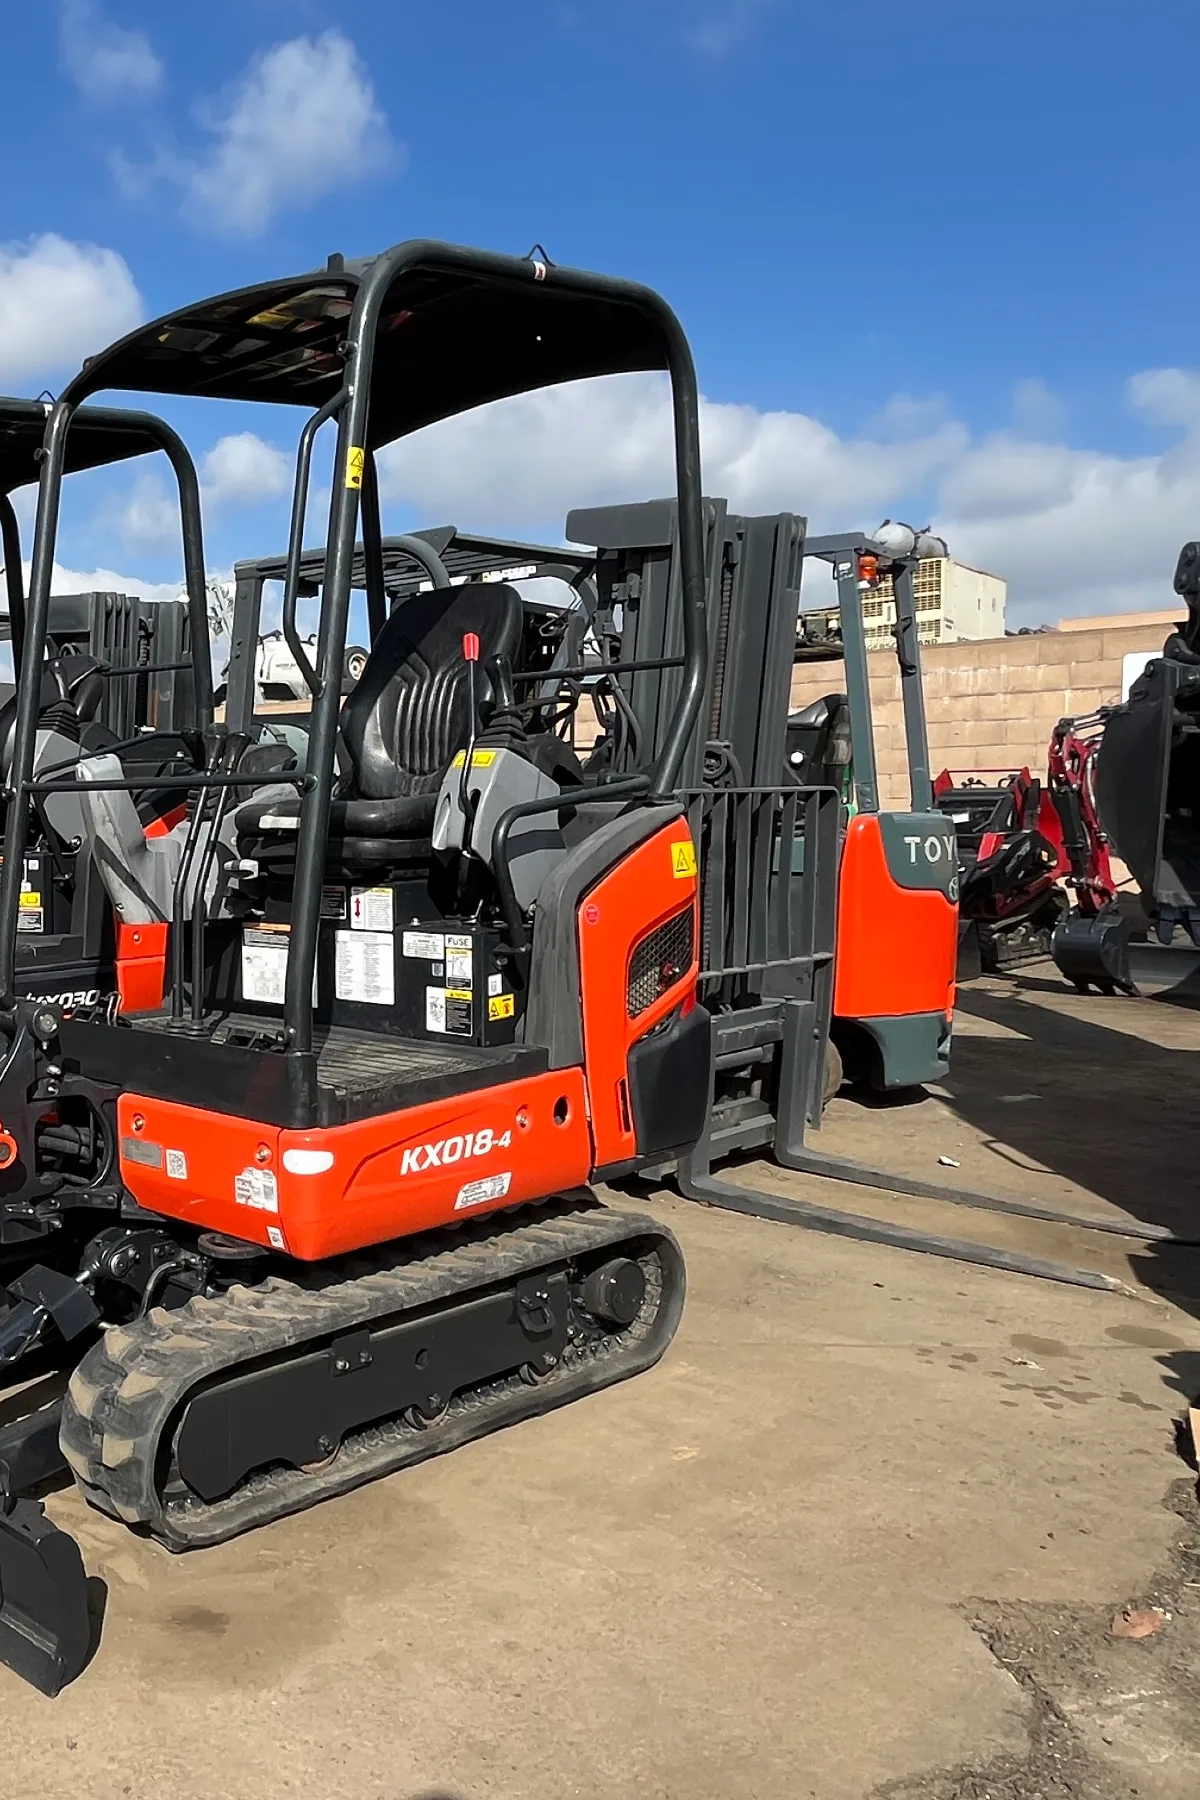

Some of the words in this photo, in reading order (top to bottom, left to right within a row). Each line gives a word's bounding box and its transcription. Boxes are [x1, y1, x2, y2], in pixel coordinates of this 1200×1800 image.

[903, 835, 958, 864] TOY
[447, 937, 469, 947] FUSE
[400, 1128, 512, 1176] KX018-4
